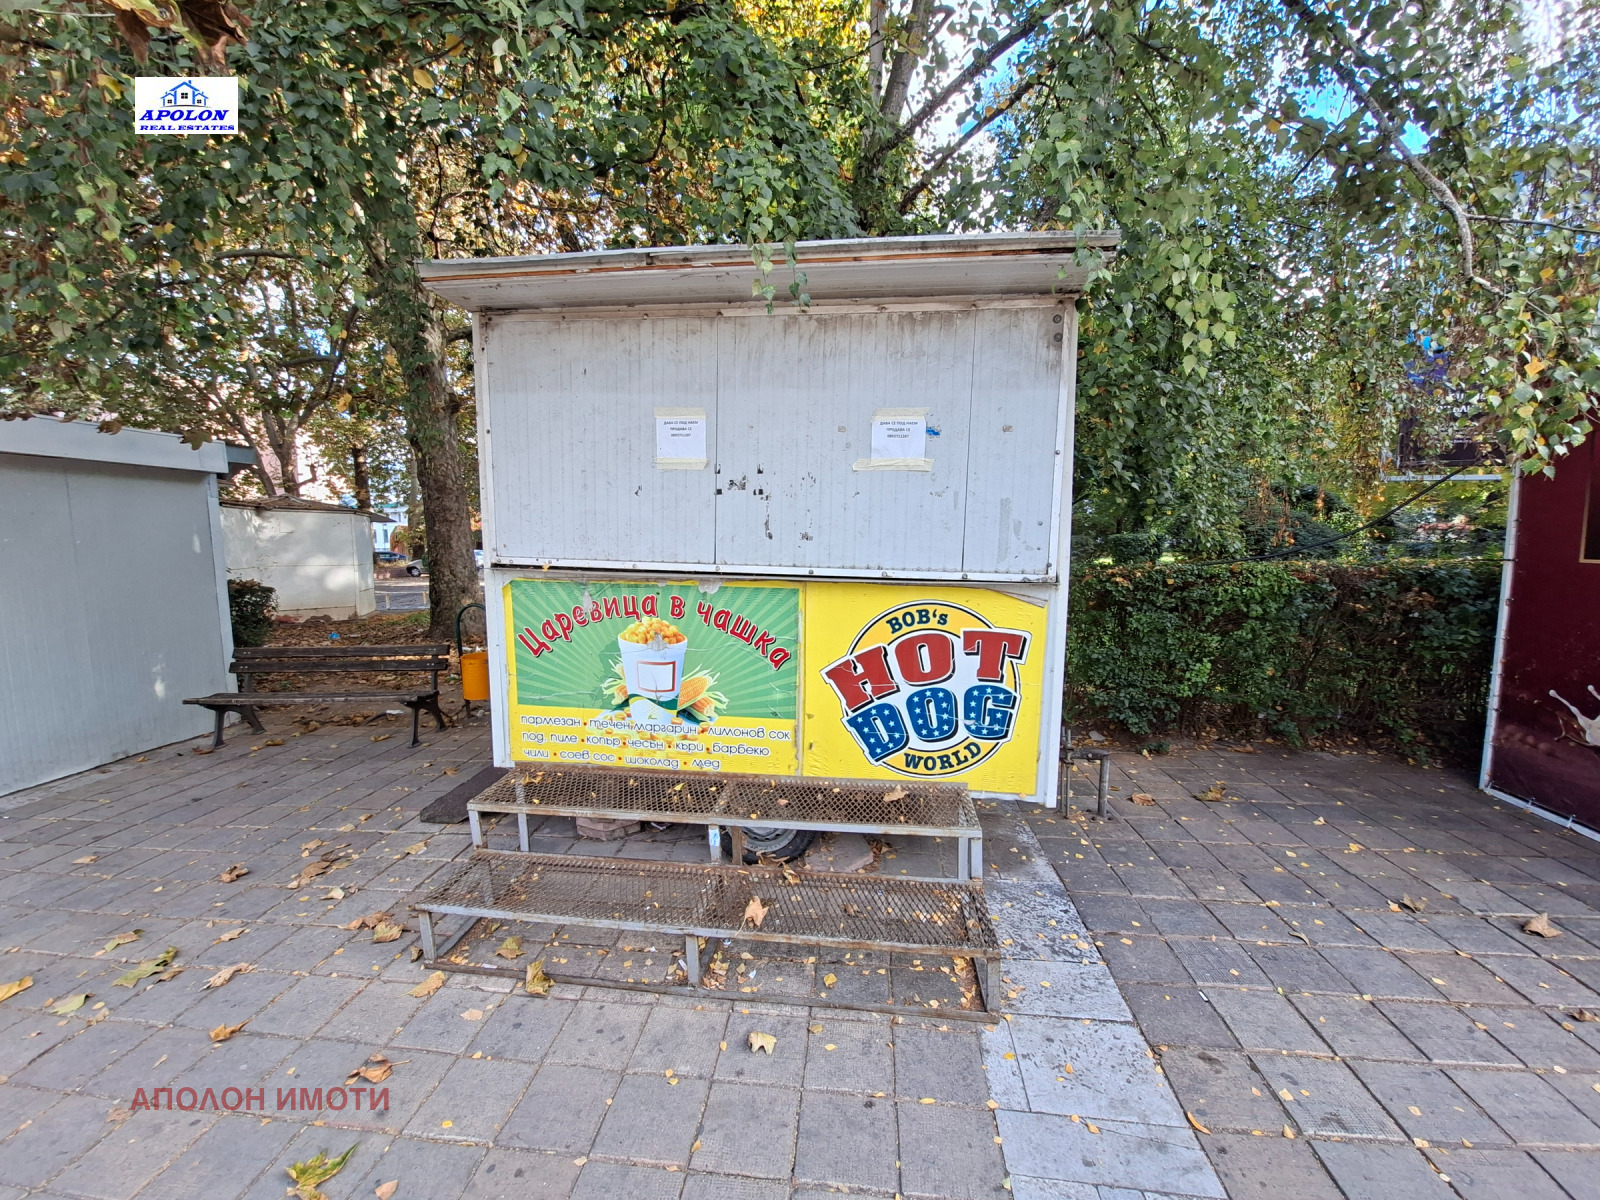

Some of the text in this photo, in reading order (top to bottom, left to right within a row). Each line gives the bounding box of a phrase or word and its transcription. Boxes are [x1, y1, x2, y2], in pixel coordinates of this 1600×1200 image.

[517, 593, 792, 671] Царевица в чашка
[824, 630, 1027, 714] HOT
[520, 715, 791, 740] пармезан течен маргарин лимонов сок
[845, 684, 1015, 762] DOG
[523, 748, 720, 770] чили соев сос шоколад мед
[550, 733, 578, 743] пиле
[586, 735, 621, 746] копър
[627, 739, 664, 749] чесън
[675, 741, 704, 752] къри
[712, 742, 770, 756] барбекю
[903, 741, 982, 771] WORLD
